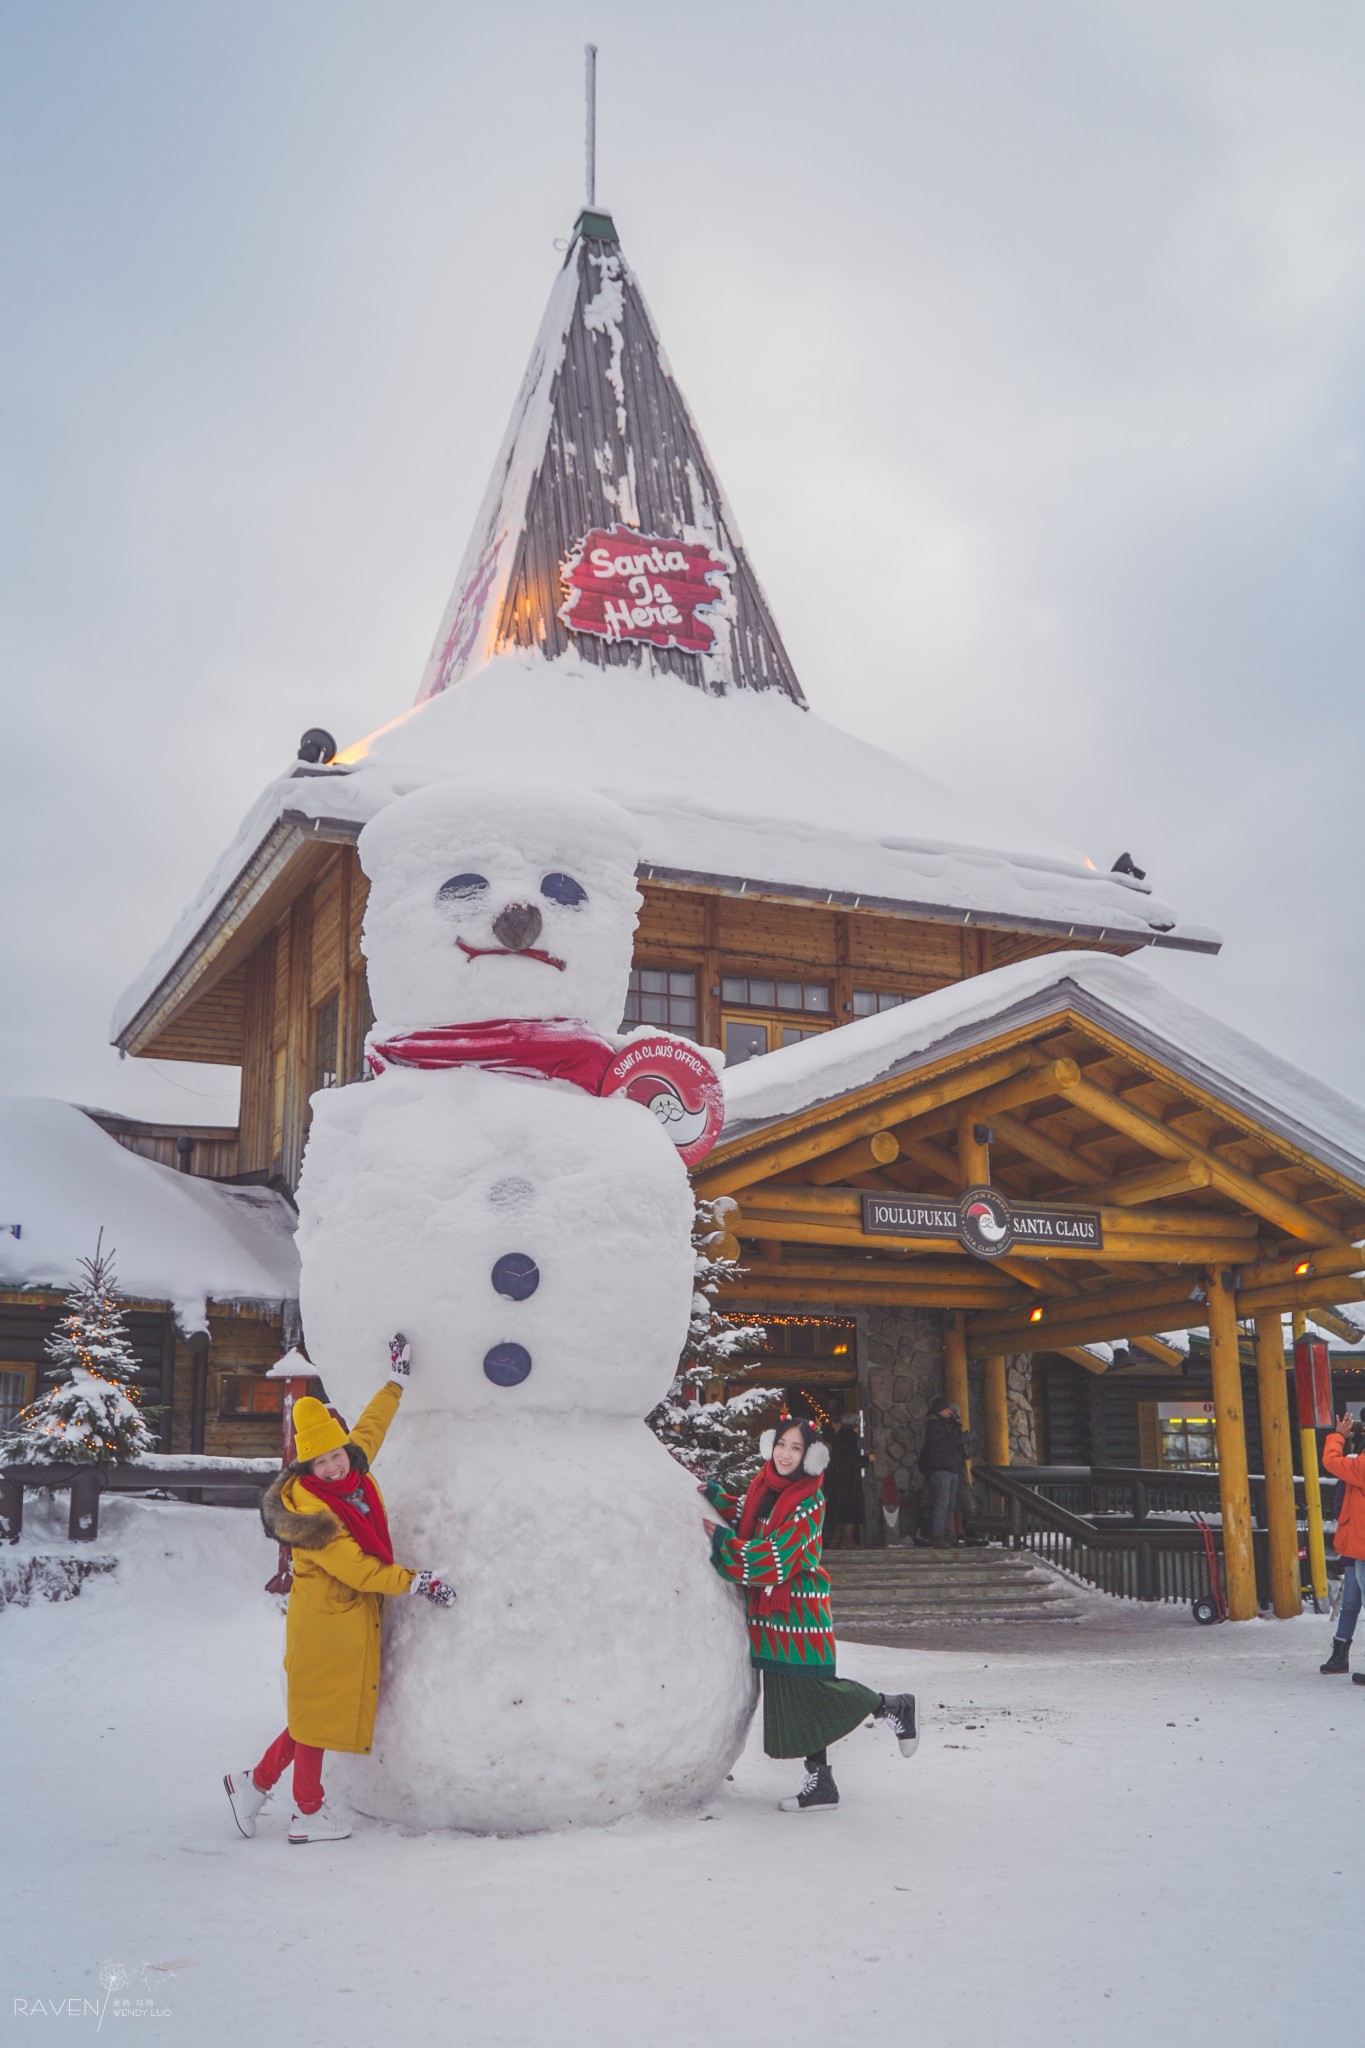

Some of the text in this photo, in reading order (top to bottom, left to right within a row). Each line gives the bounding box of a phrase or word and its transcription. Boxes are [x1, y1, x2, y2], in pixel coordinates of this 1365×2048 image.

[590, 547, 690, 578] Santa
[628, 575, 673, 606] Is
[603, 599, 683, 631] Here
[613, 1045, 706, 1078] SANTA CLAUS OFFICE
[874, 1206, 957, 1228] JOULUPUKKI
[1013, 1217, 1095, 1238] SANTA CLAUS
